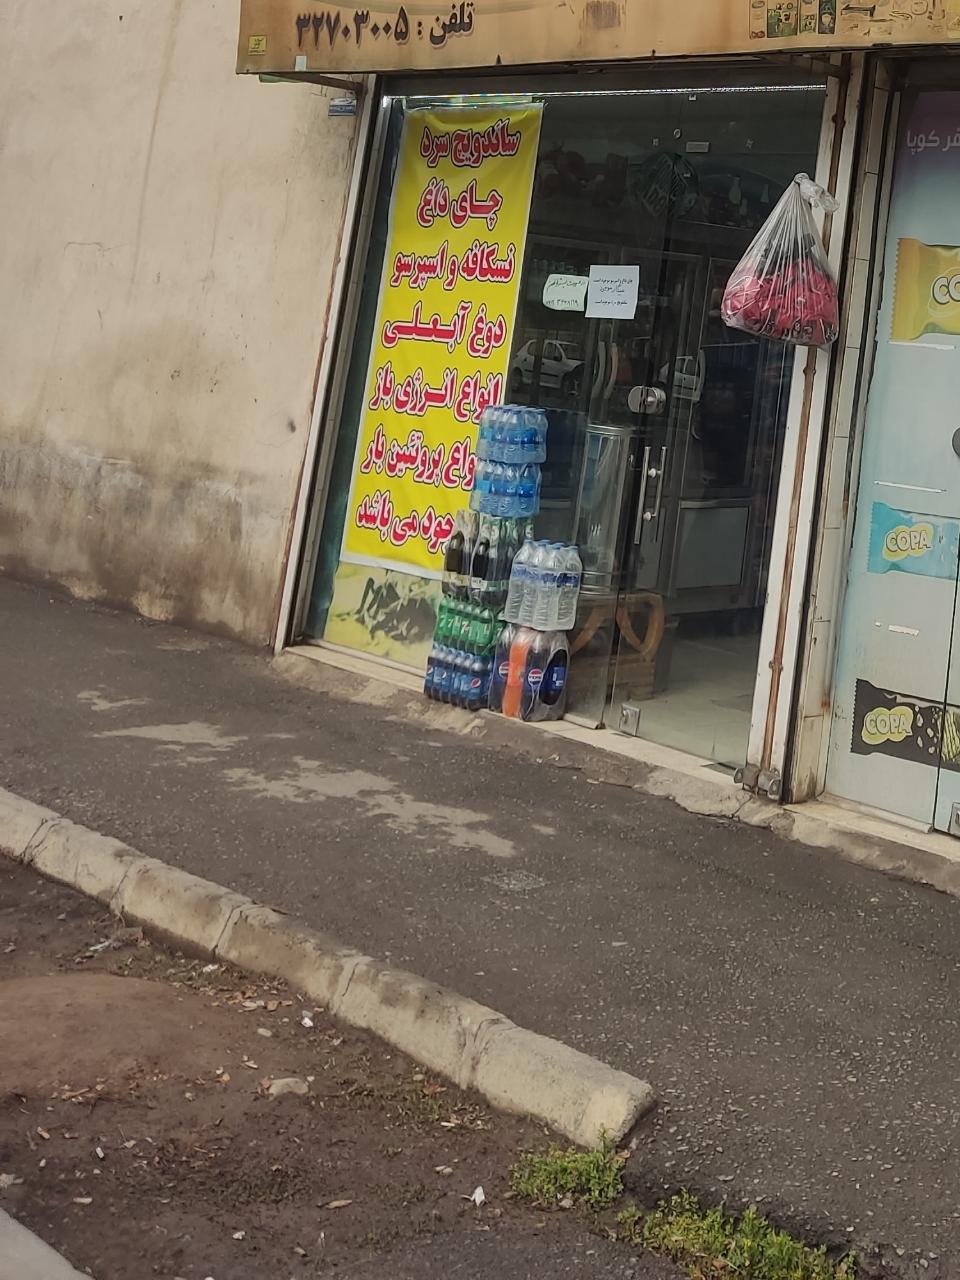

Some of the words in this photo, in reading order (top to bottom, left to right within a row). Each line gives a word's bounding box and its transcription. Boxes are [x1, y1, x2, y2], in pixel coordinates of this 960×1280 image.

[295, 5, 410, 49] ۳۲۷۰۳۰۰۵
[429, 1, 475, 47] تلفن
[420, 126, 450, 169] سرد
[451, 117, 522, 169] ساندویچ
[906, 129, 939, 155] کوپا
[417, 176, 450, 229] داغ
[450, 178, 503, 231] چای
[389, 239, 449, 292] اسپرسو
[443, 254, 458, 292] و
[460, 238, 517, 283] نسکافه
[382, 300, 472, 354] آبعلی
[467, 303, 507, 358] دوغ
[393, 367, 458, 417] انرژی
[454, 369, 503, 425] انواع
[360, 423, 386, 475] بار
[385, 429, 445, 488] پروتئین
[442, 435, 477, 492] واع
[355, 488, 394, 542] باشد
[390, 509, 420, 547] می
[420, 505, 456, 555] جود
[885, 529, 932, 553] COPA
[863, 711, 913, 737] COPA
